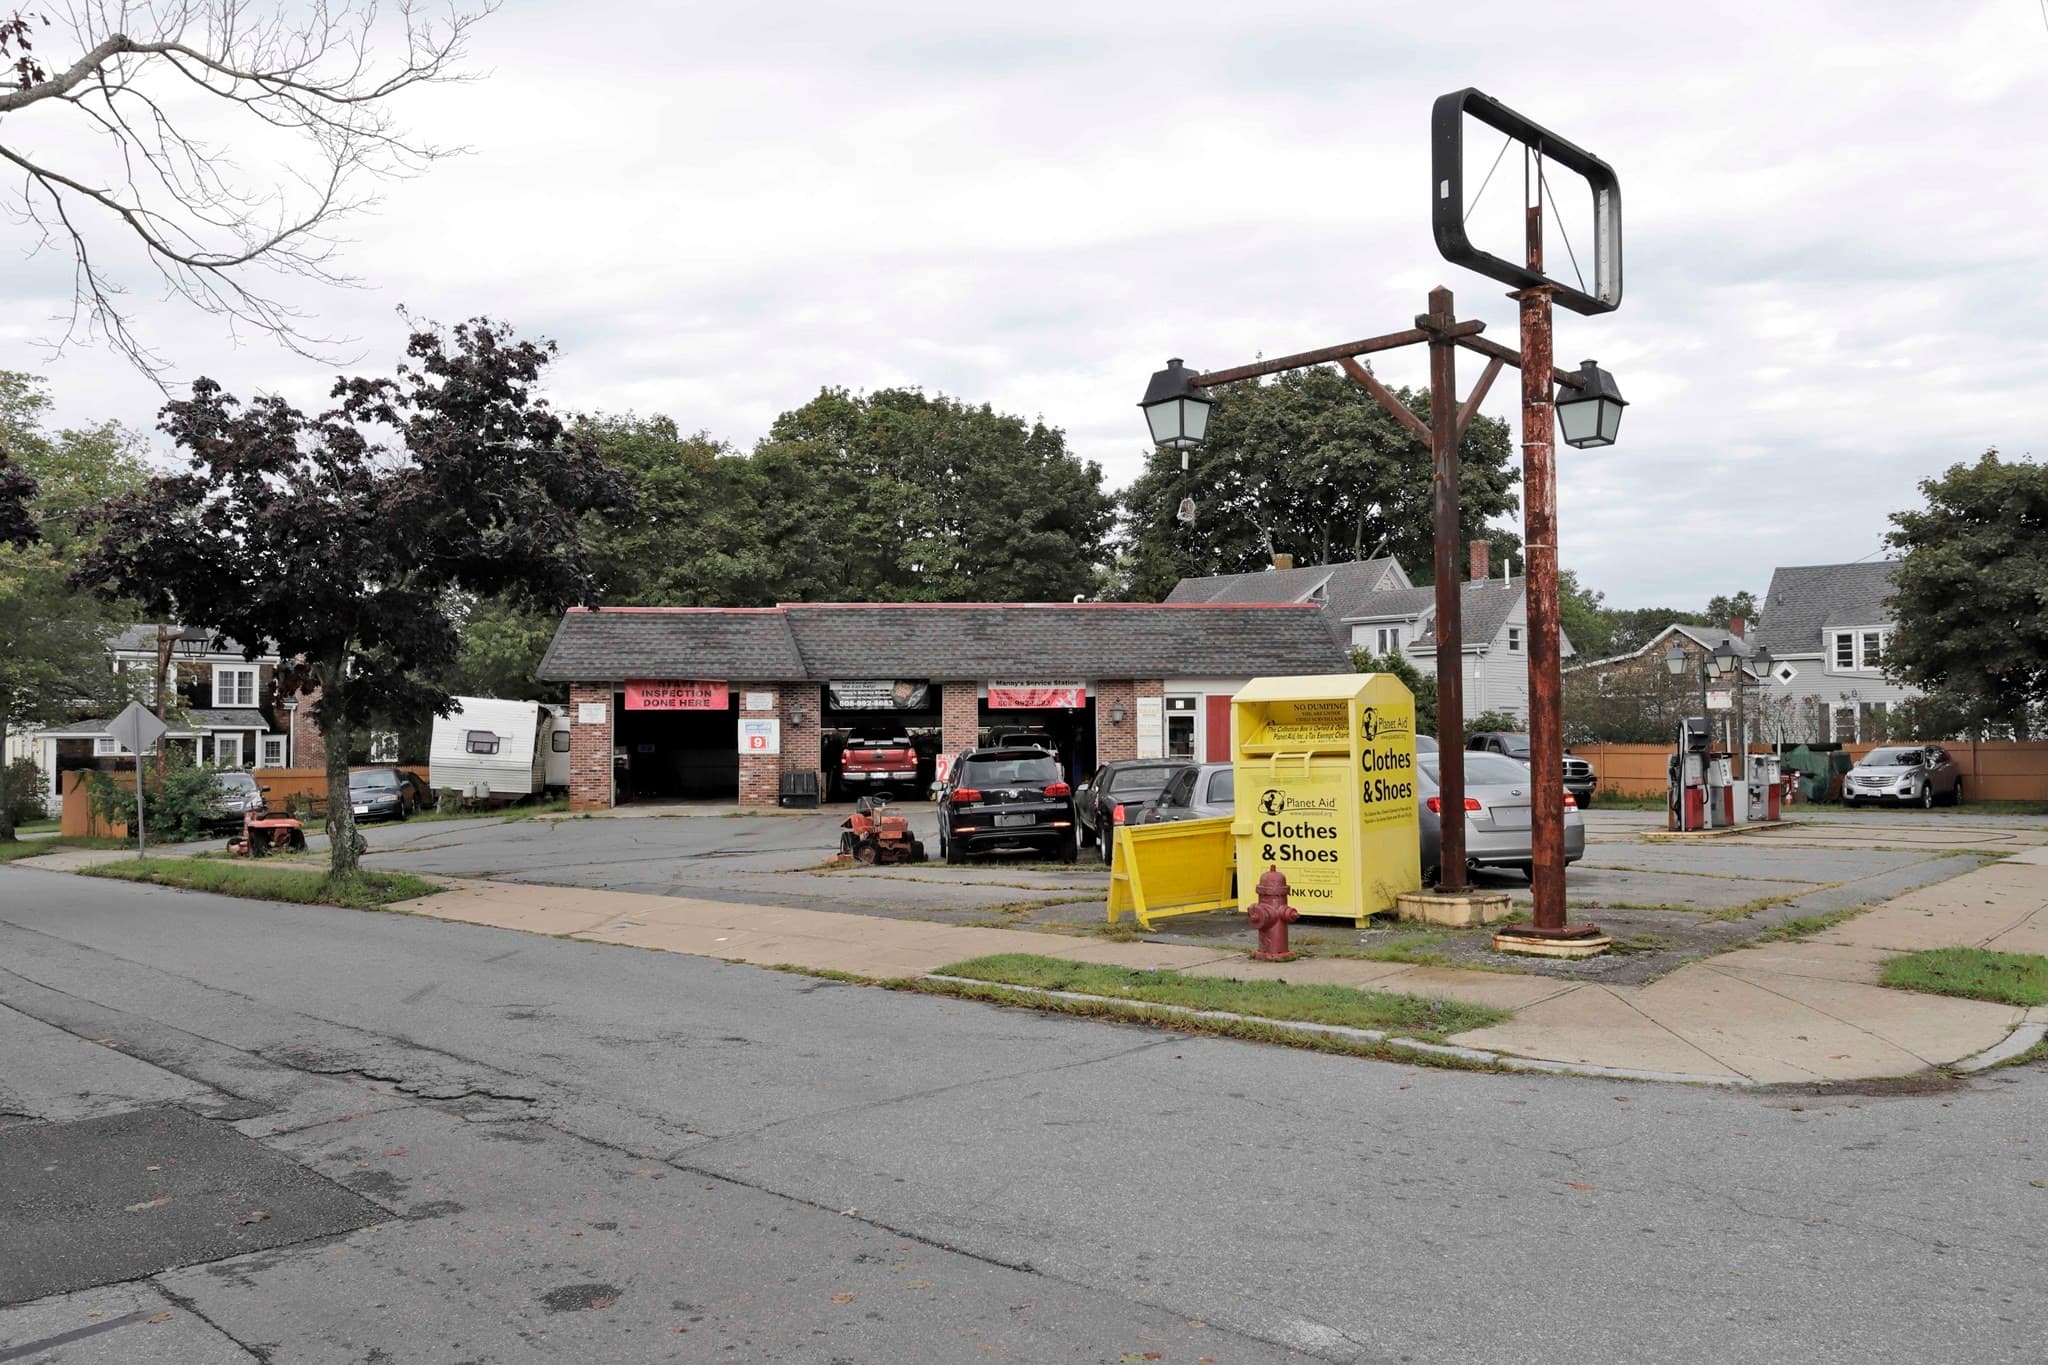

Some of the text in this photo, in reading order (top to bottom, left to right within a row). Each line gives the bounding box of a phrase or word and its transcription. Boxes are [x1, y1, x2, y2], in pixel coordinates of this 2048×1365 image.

[995, 679, 1024, 688] Manny's
[641, 689, 712, 697] INSPECTION
[643, 699, 711, 707] DONE HERE
[1379, 716, 1407, 729] Planet Aid
[753, 737, 763, 748] 9
[1362, 748, 1411, 772] Clothes
[938, 760, 948, 781] 2
[1363, 778, 1412, 803] & Shoes
[1286, 797, 1335, 808] Planet Aid
[1261, 821, 1337, 839] Clothes
[1262, 843, 1338, 862] & Shoes
[1307, 889, 1333, 898] YOU!
